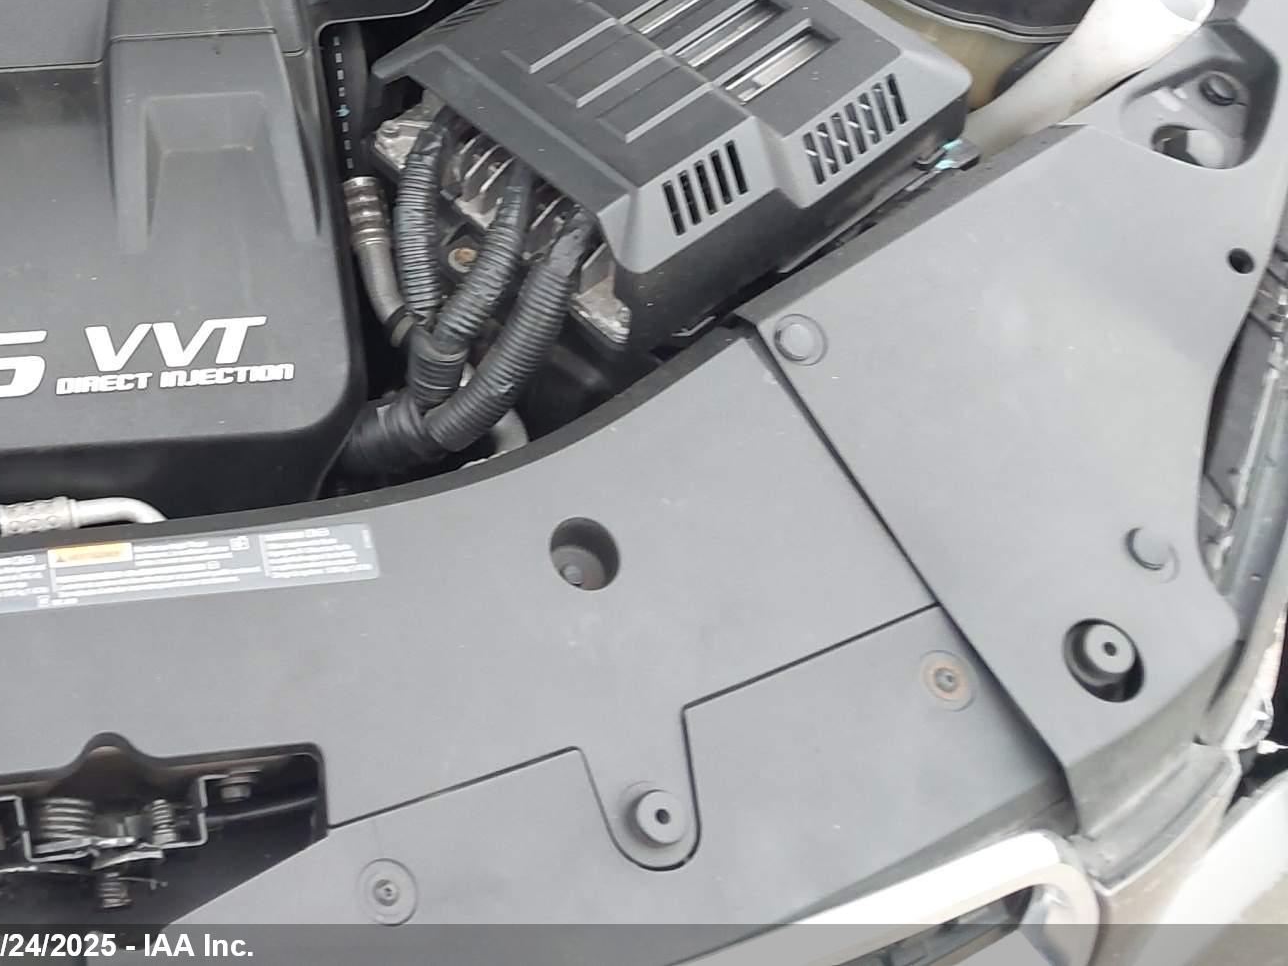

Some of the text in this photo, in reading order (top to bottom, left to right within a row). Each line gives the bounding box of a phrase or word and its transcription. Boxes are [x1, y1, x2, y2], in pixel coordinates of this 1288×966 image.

[84, 315, 268, 372] VVT
[56, 362, 295, 396] DIRECT INJECTION
